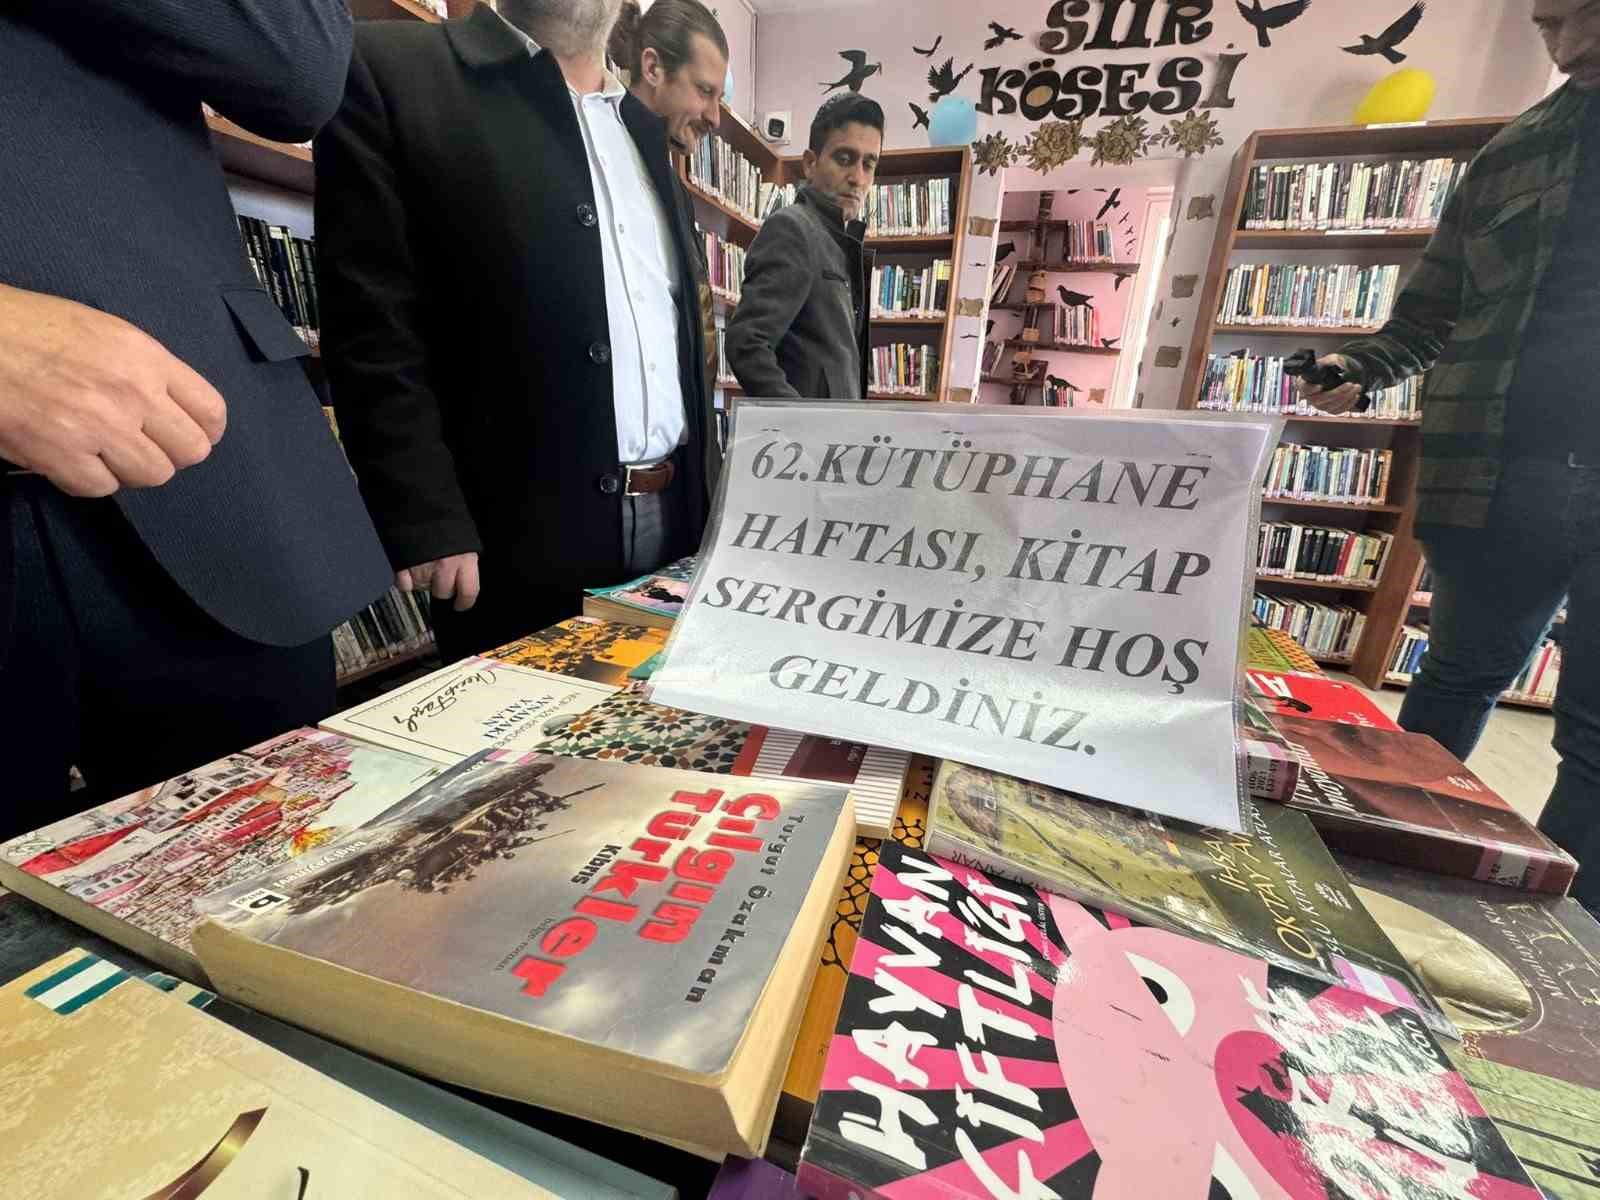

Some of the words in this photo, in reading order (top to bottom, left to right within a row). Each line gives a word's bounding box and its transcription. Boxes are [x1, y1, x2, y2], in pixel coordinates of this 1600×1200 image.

[751, 434, 1208, 511] 62.KÜTÜPHANE
[728, 512, 986, 583] HAFTASI,
[1005, 528, 1211, 596] KİTAP
[699, 576, 1044, 663] SERGİMİZE
[1055, 625, 1209, 694] HOŞ
[768, 653, 1098, 756] GELDİNİZ.
[511, 787, 726, 999] Türkler
[570, 844, 623, 886] Kıbrıs
[638, 792, 783, 944] Çılgın
[761, 815, 806, 876] Turgut
[684, 884, 773, 1004] Özakman
[1242, 863, 1317, 959] OKTAY
[838, 854, 954, 1170] HAYVAN
